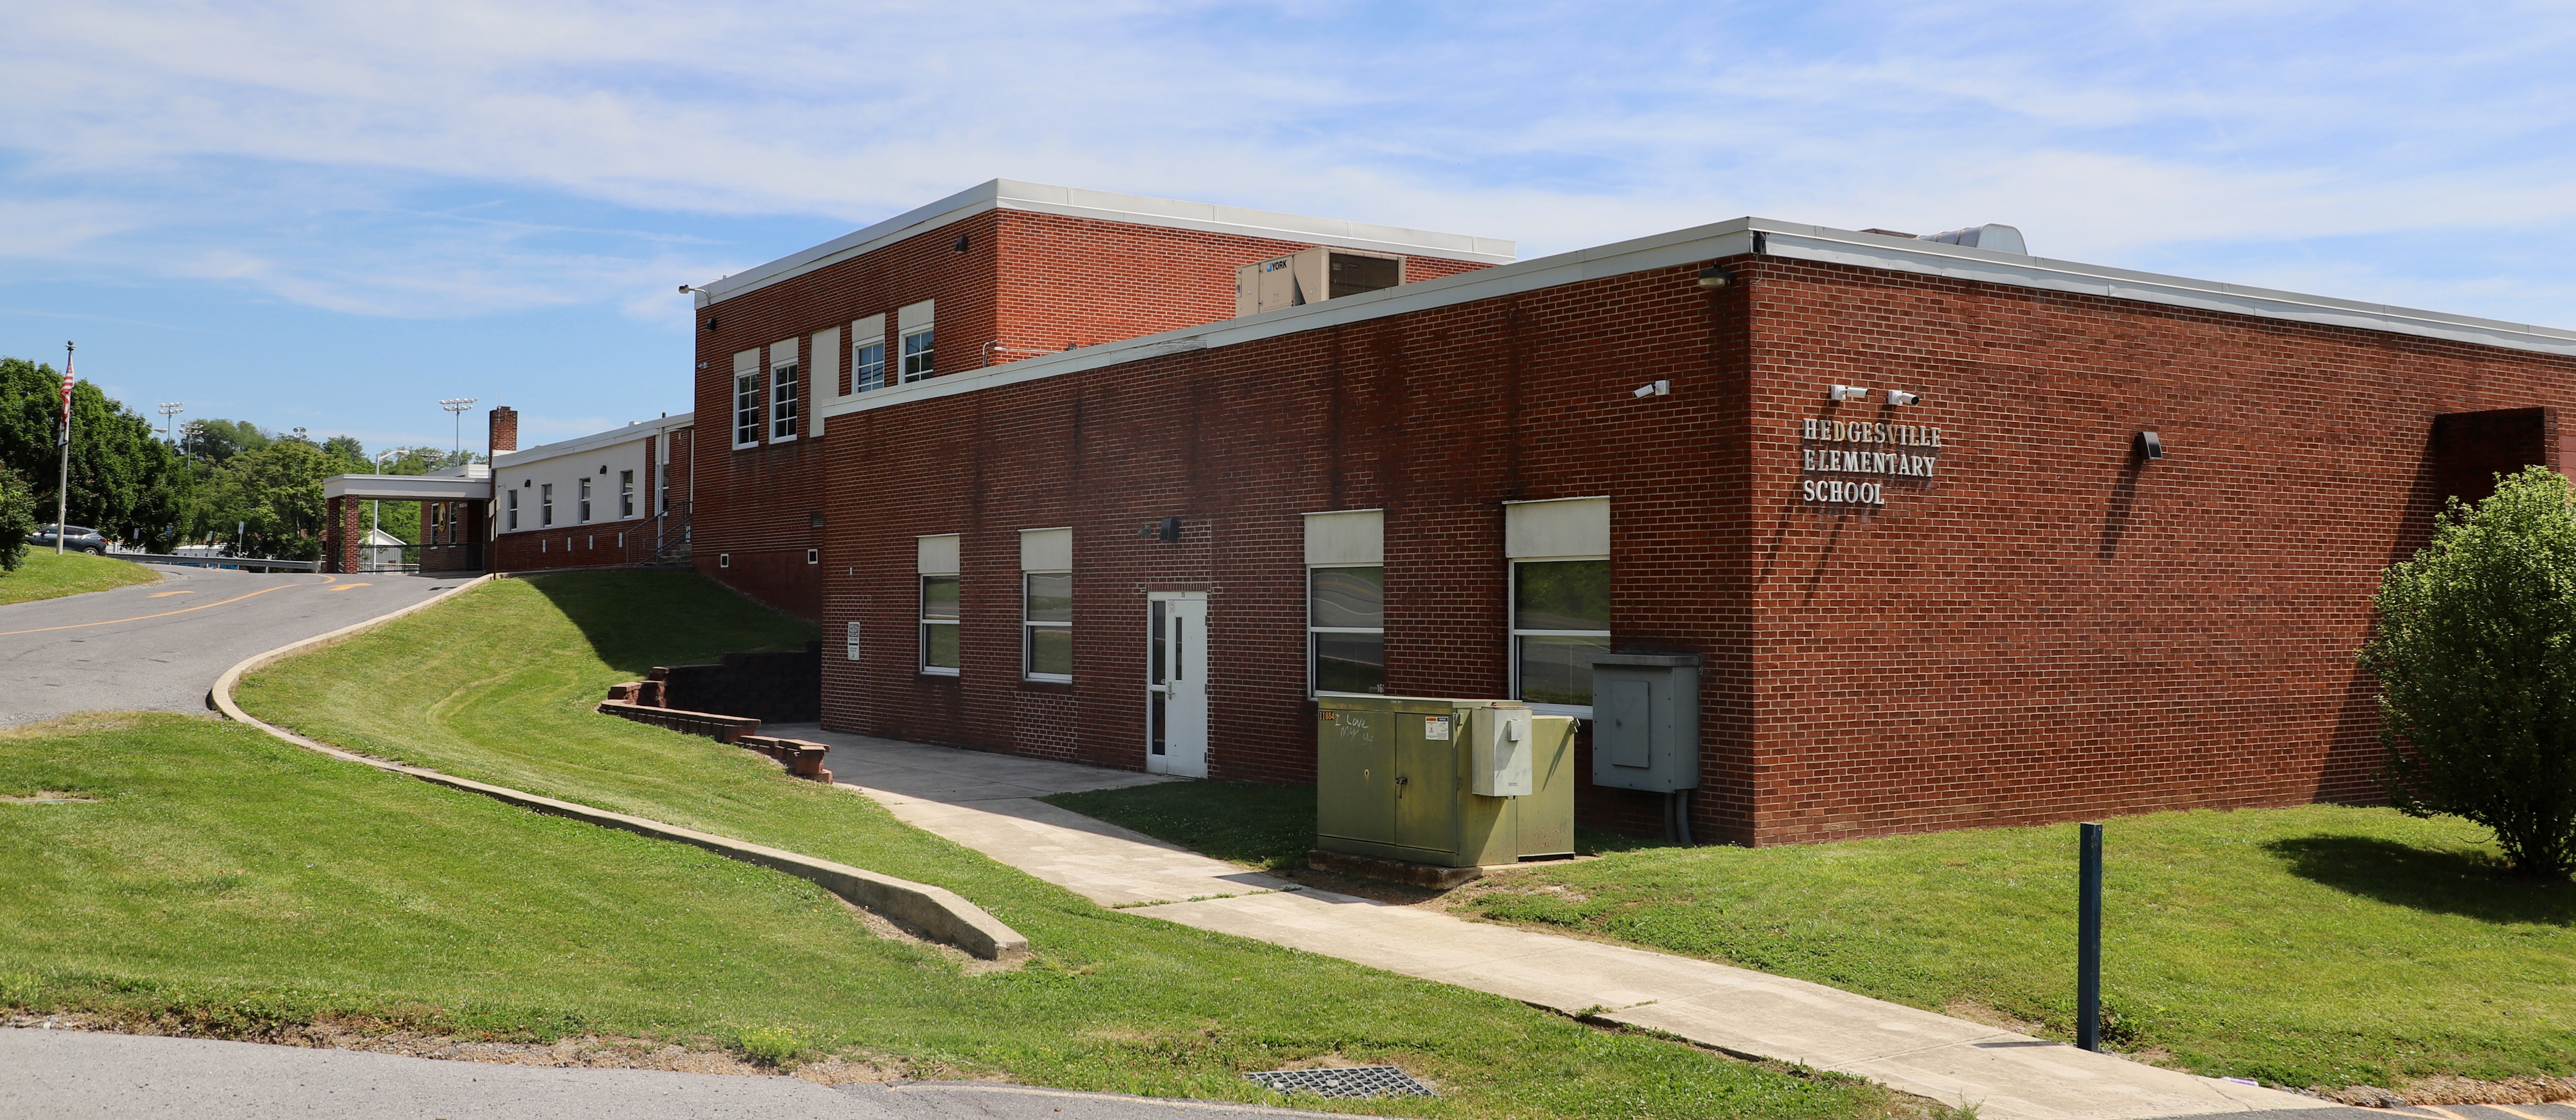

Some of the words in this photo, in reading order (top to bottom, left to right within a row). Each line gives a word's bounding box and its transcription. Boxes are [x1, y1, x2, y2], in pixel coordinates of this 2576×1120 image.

[1272, 260, 1287, 271] YORK
[1803, 418, 1941, 447] HEDGESVILLE
[1803, 449, 1936, 477] ELEMENTARY
[1803, 480, 1885, 505] SCHOOL
[1168, 601, 1175, 613] 13
[1319, 712, 1334, 720] 11884
[1335, 714, 1340, 726] I
